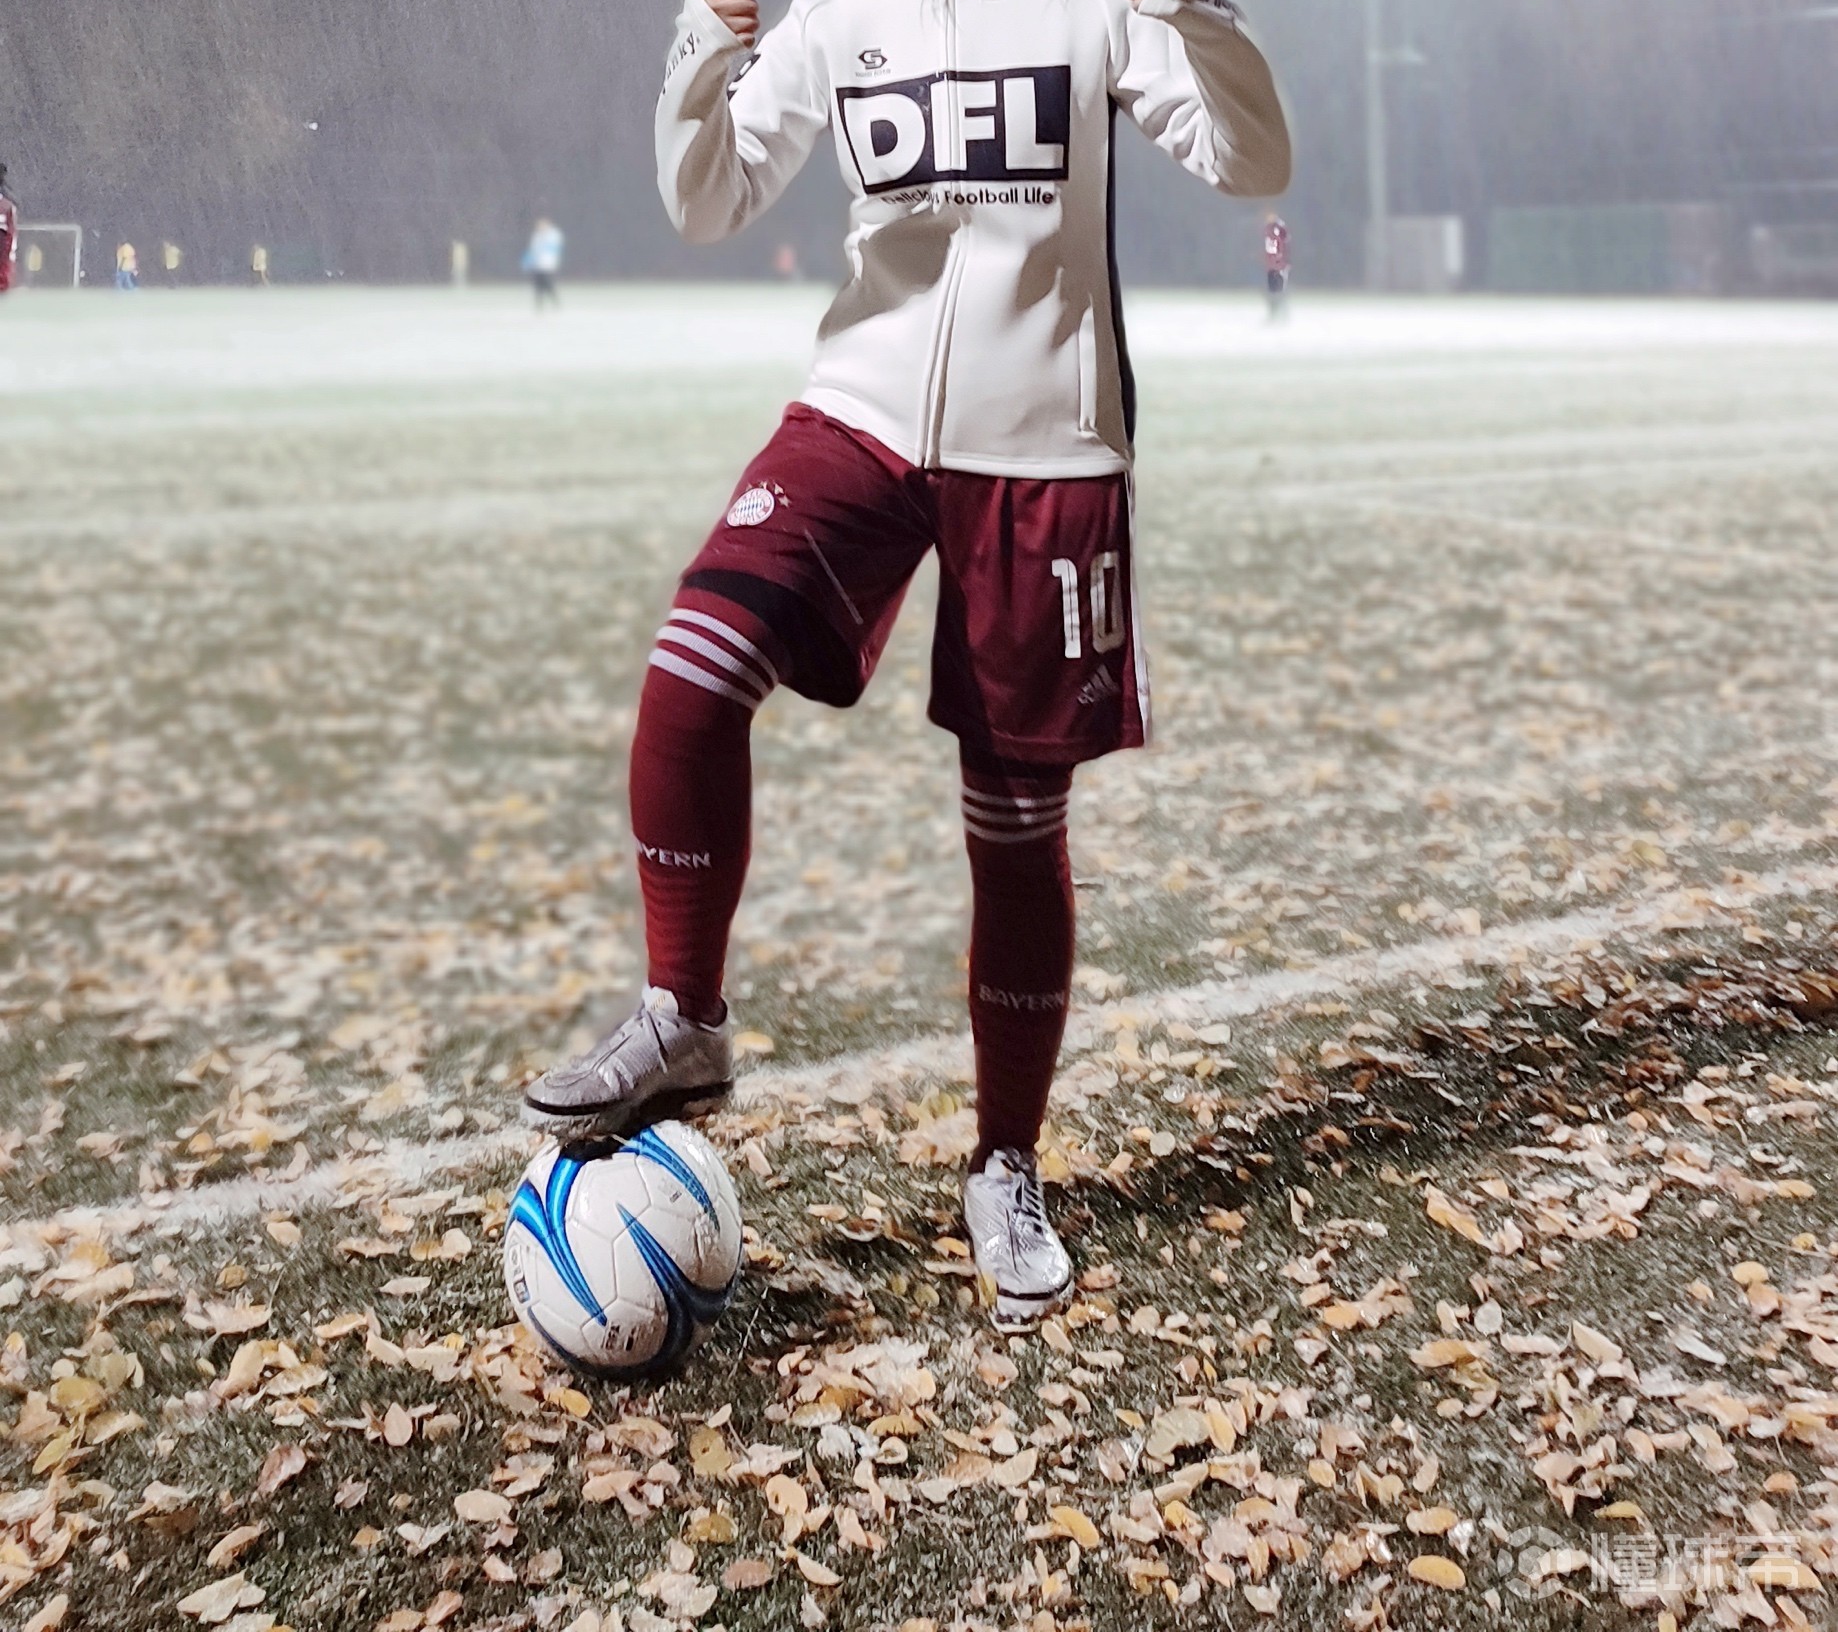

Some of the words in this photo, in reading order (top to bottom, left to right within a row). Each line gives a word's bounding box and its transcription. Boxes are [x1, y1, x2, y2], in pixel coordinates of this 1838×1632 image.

[843, 76, 1065, 186] DFL
[944, 186, 1019, 206] Football
[1024, 186, 1054, 205] Life
[1051, 550, 1126, 659] 10
[637, 840, 712, 869] YERN
